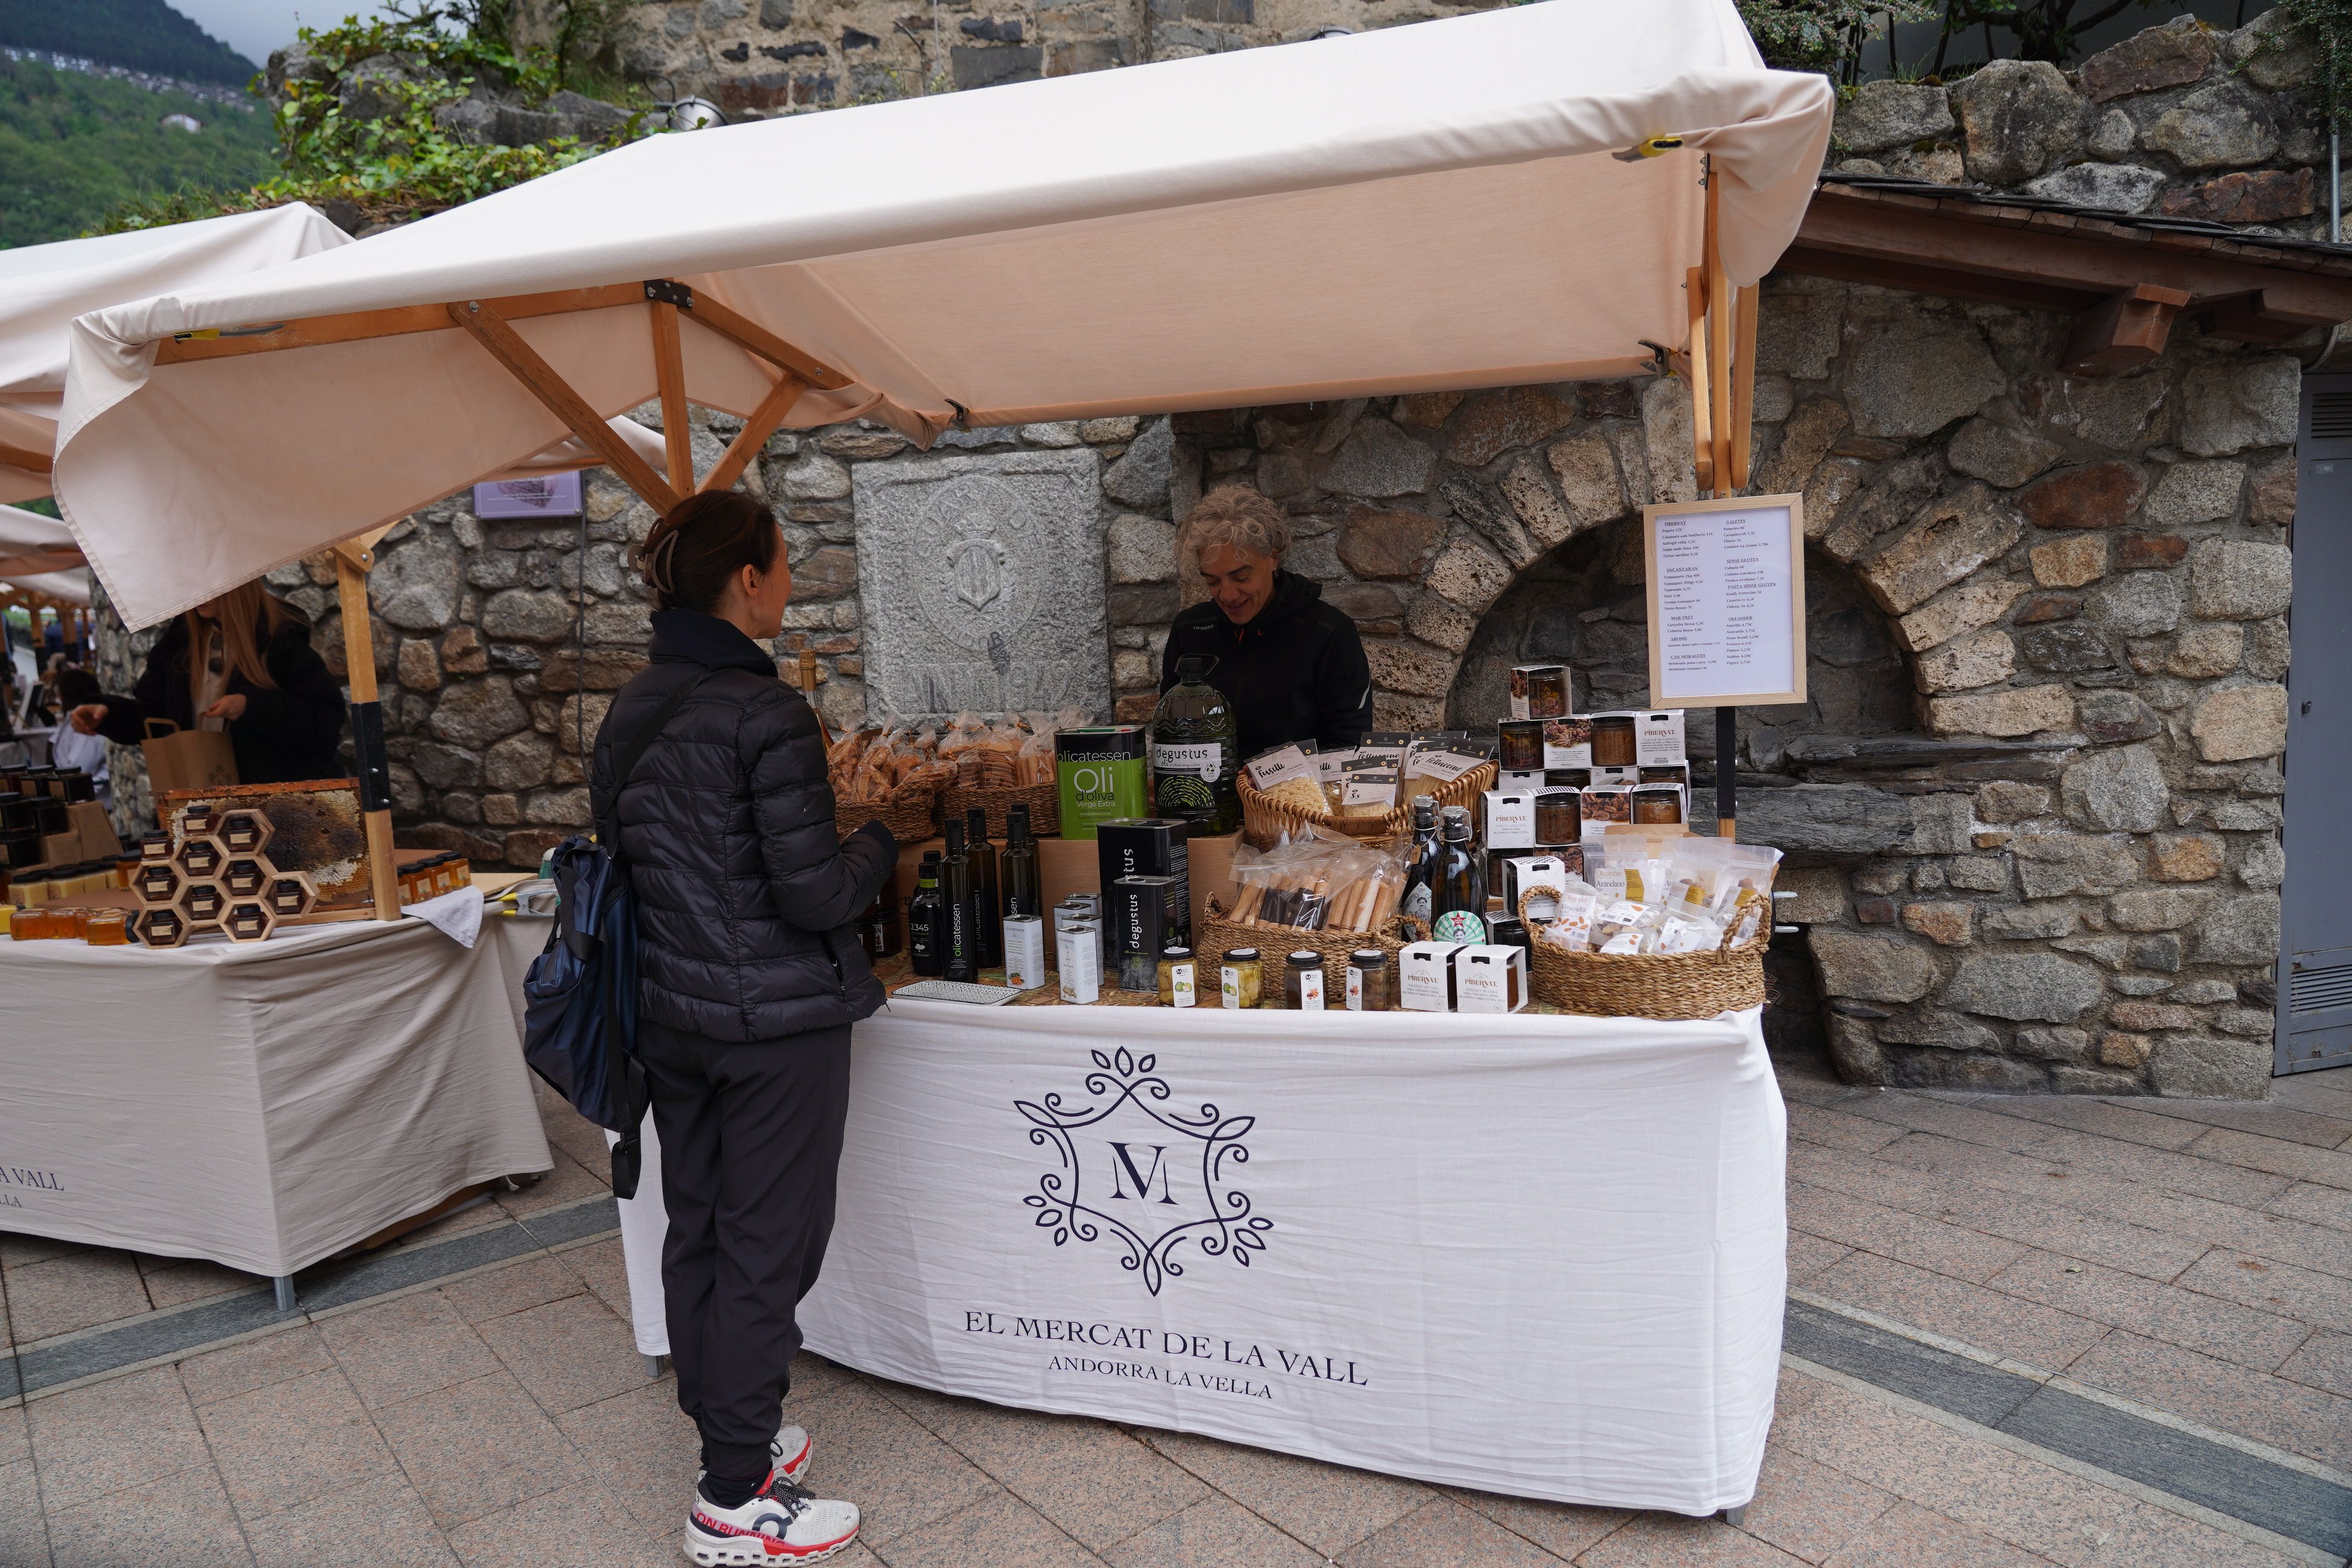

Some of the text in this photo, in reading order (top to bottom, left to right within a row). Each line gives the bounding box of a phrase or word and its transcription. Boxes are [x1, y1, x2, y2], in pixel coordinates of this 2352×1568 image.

[1057, 751, 1131, 762] olicatessen
[1157, 746, 1208, 763] degustus
[1074, 767, 1113, 793] Oli
[1258, 762, 1285, 778] fusilli
[1076, 790, 1114, 801] d'oliva
[953, 904, 961, 957] olicatessen
[1129, 894, 1142, 948] degustus
[11, 1168, 64, 1191] VALL
[964, 1311, 1370, 1388] EL MERCAT DE LA VALL
[1048, 1355, 1274, 1400] ANDORRA LA VELLA
[697, 1512, 718, 1529] ON
